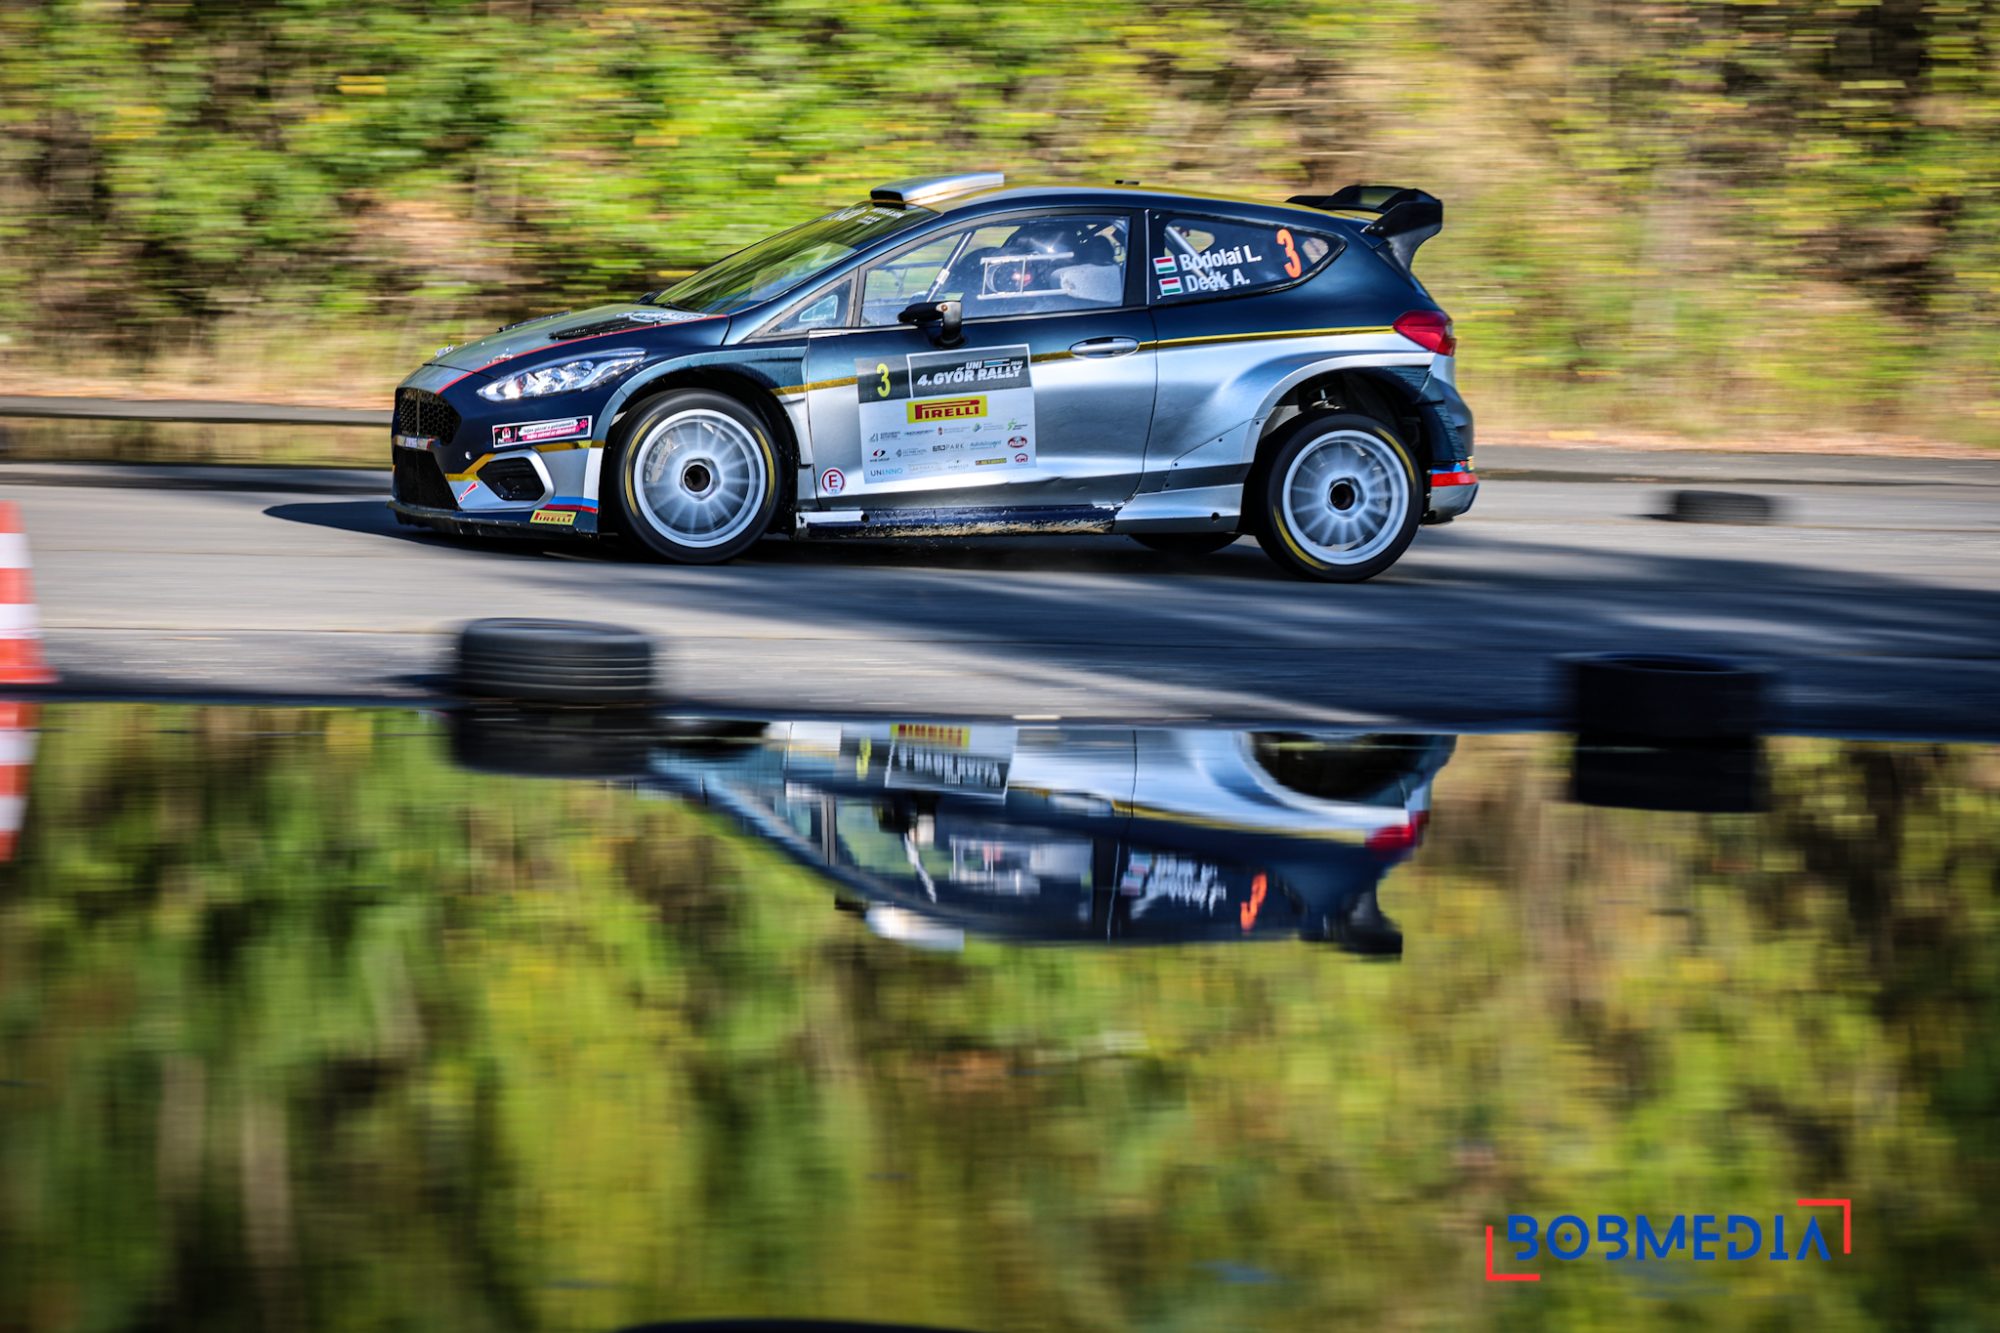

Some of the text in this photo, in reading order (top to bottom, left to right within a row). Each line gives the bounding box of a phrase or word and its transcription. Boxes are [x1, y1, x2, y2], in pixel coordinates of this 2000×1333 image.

[1178, 244, 1262, 271] Bodolai L.
[1276, 228, 1302, 279] 3
[1232, 268, 1250, 286] A.
[965, 359, 982, 370] UNI
[977, 364, 1023, 382] RALLY
[876, 363, 891, 398] 3
[915, 399, 980, 420] PIRELLI
[828, 474, 838, 488] E
[533, 511, 573, 523] PIRELLI
